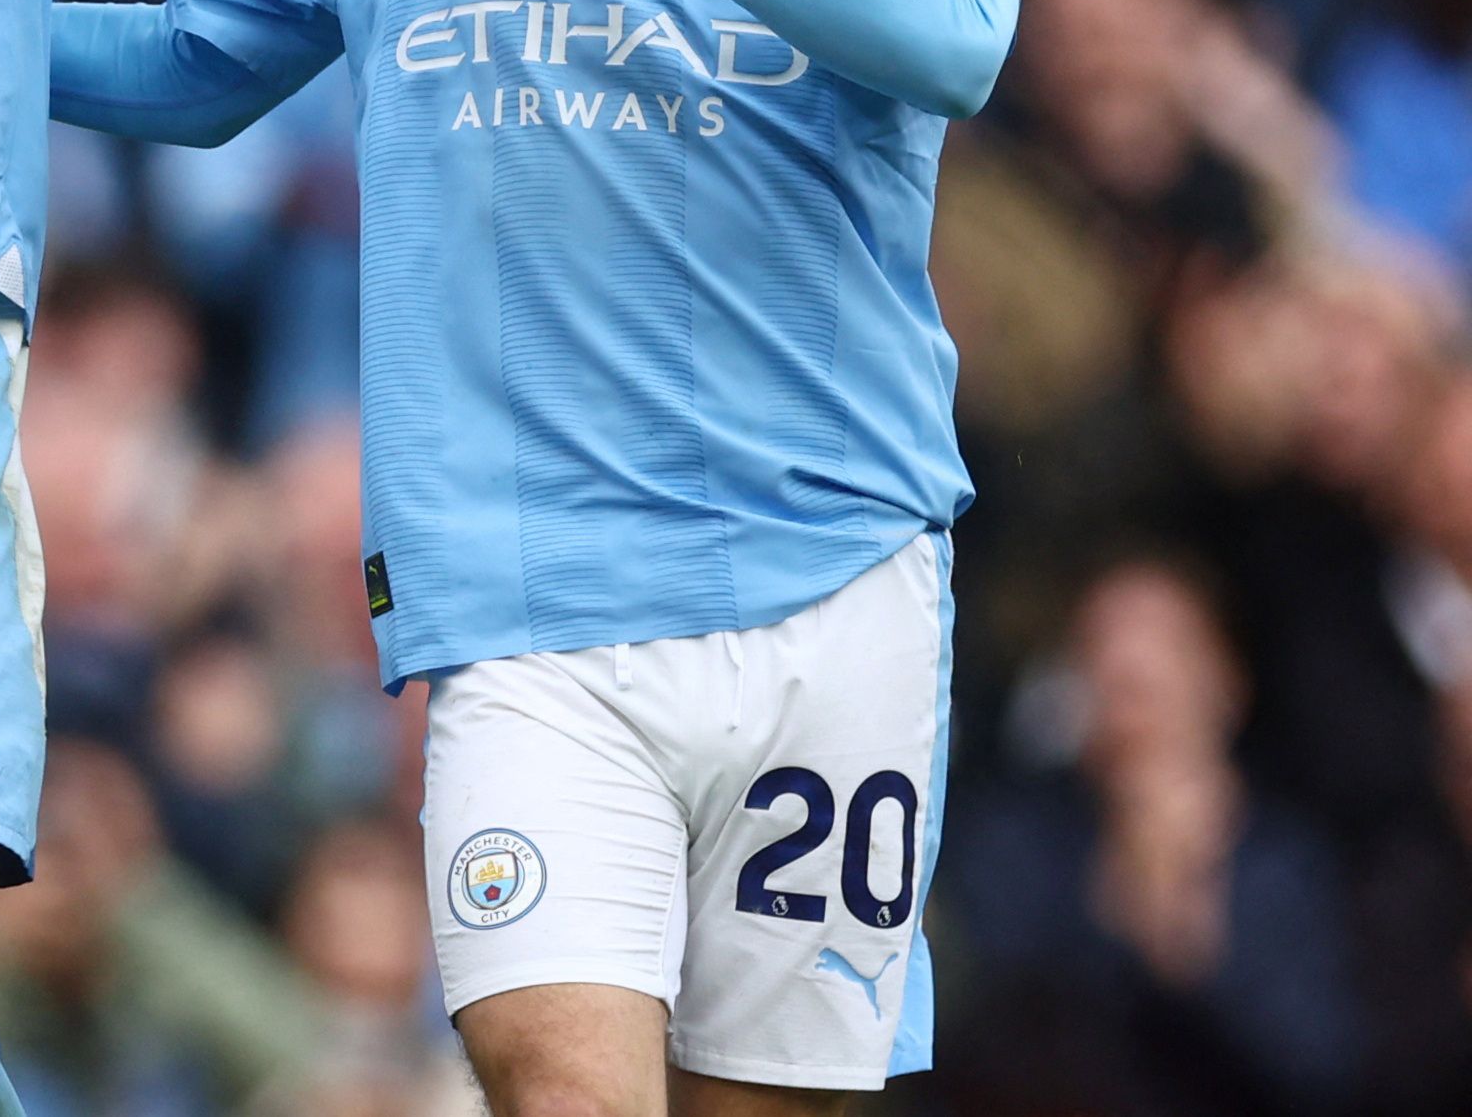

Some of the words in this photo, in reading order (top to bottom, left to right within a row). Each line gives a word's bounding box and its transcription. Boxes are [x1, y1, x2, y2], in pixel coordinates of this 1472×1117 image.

[395, 0, 810, 86] ETIHAD
[451, 87, 725, 137] AIRWAYS
[455, 836, 533, 876] MANCHESTER
[735, 766, 918, 930] 20
[481, 909, 509, 923] CITY
